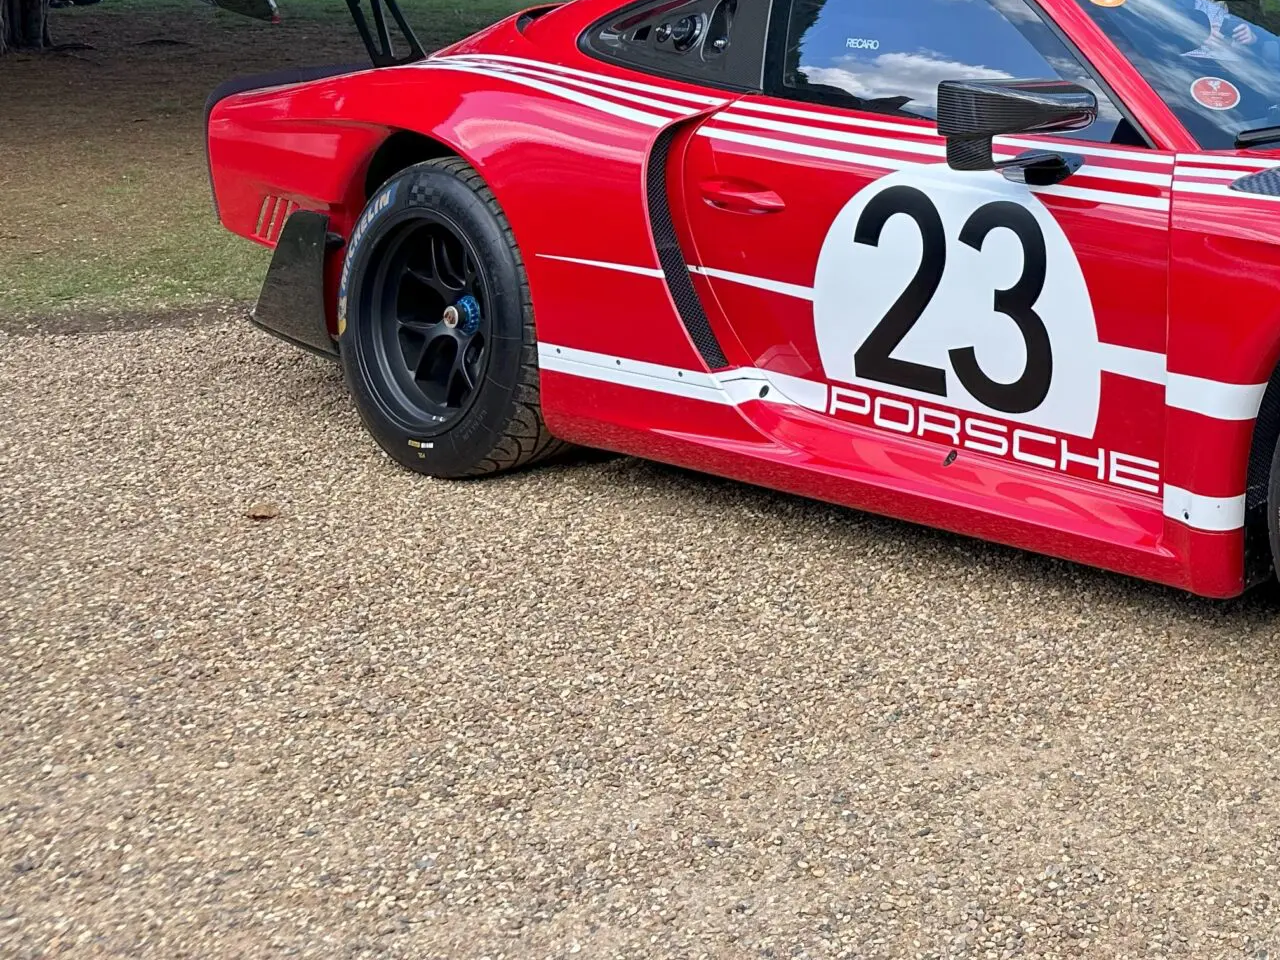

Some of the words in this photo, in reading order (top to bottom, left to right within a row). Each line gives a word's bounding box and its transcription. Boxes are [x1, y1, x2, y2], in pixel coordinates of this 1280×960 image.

[846, 38, 879, 50] RECARO
[341, 189, 392, 290] MICHELIN
[853, 184, 1053, 414] 23
[829, 386, 1160, 493] PORSCHE
